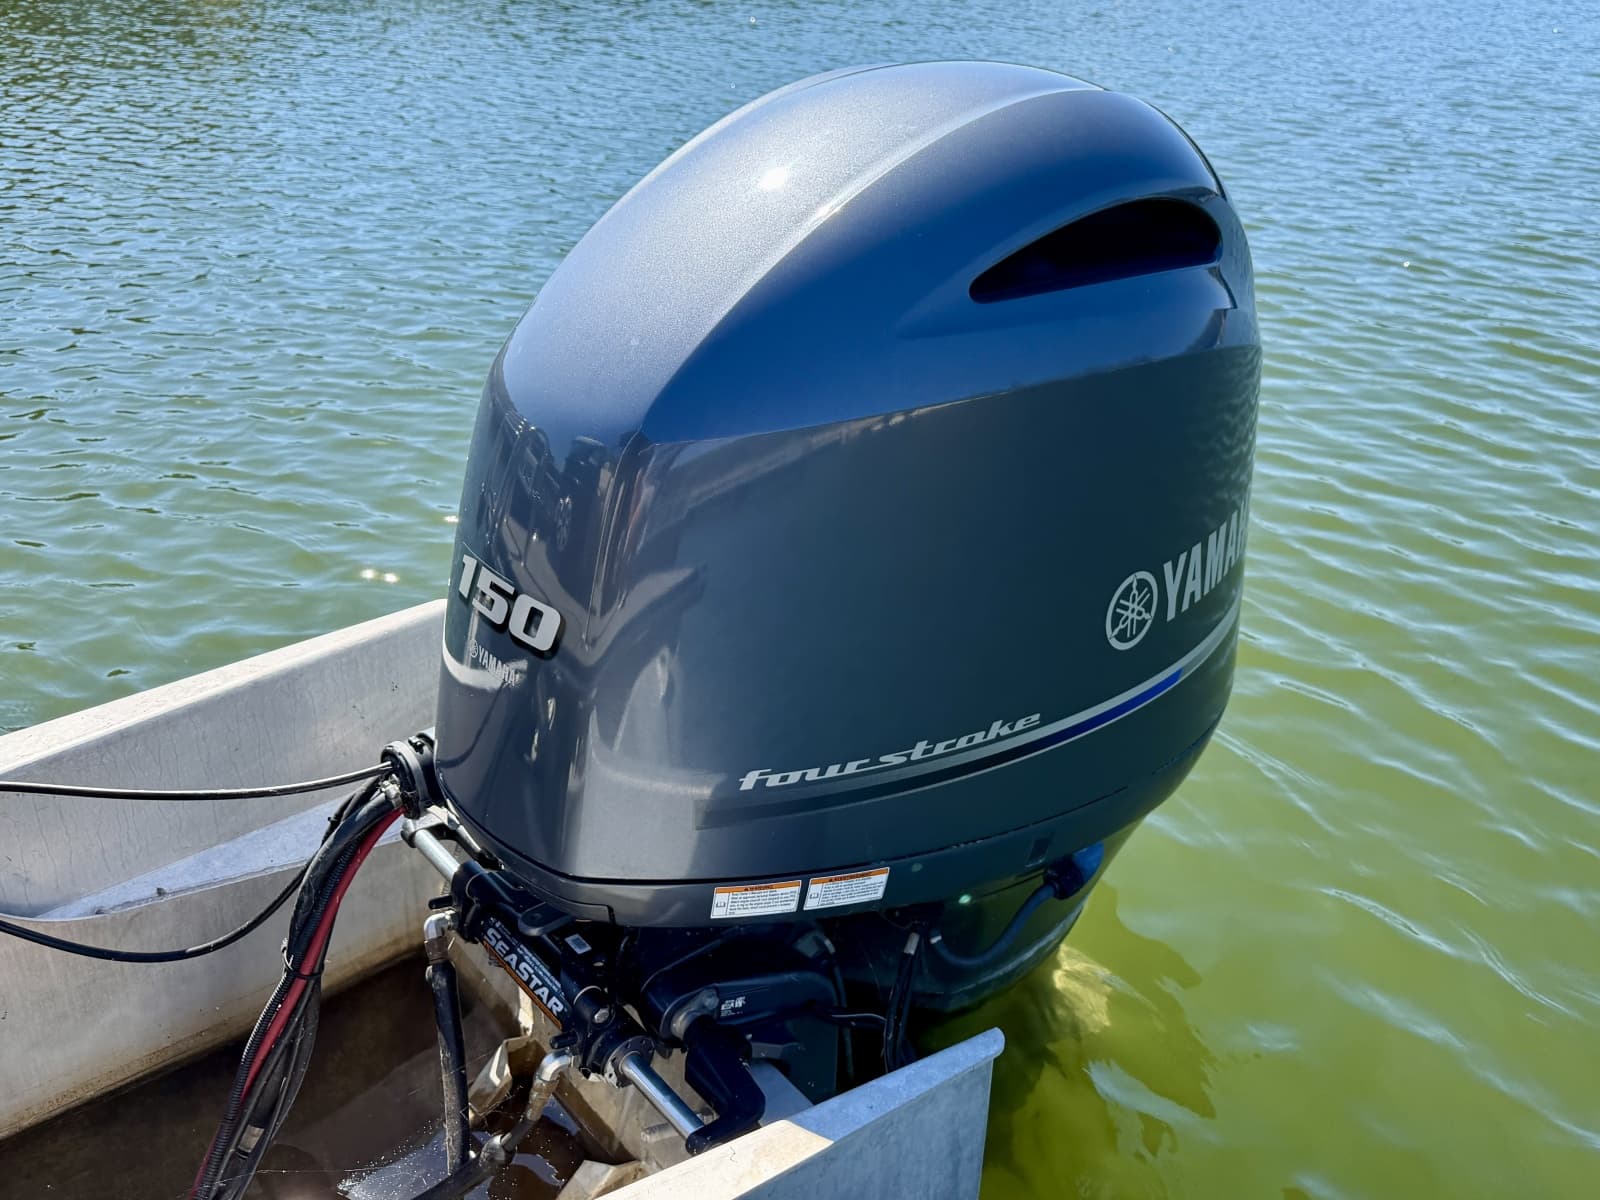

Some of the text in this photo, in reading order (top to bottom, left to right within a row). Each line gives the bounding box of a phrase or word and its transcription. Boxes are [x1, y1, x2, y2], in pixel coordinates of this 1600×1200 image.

[459, 554, 562, 652] 150
[1163, 498, 1248, 622] YAMAH
[478, 644, 516, 687] YAMAHA
[739, 713, 1041, 791] four stroke
[485, 927, 564, 1016] SEASTAR
